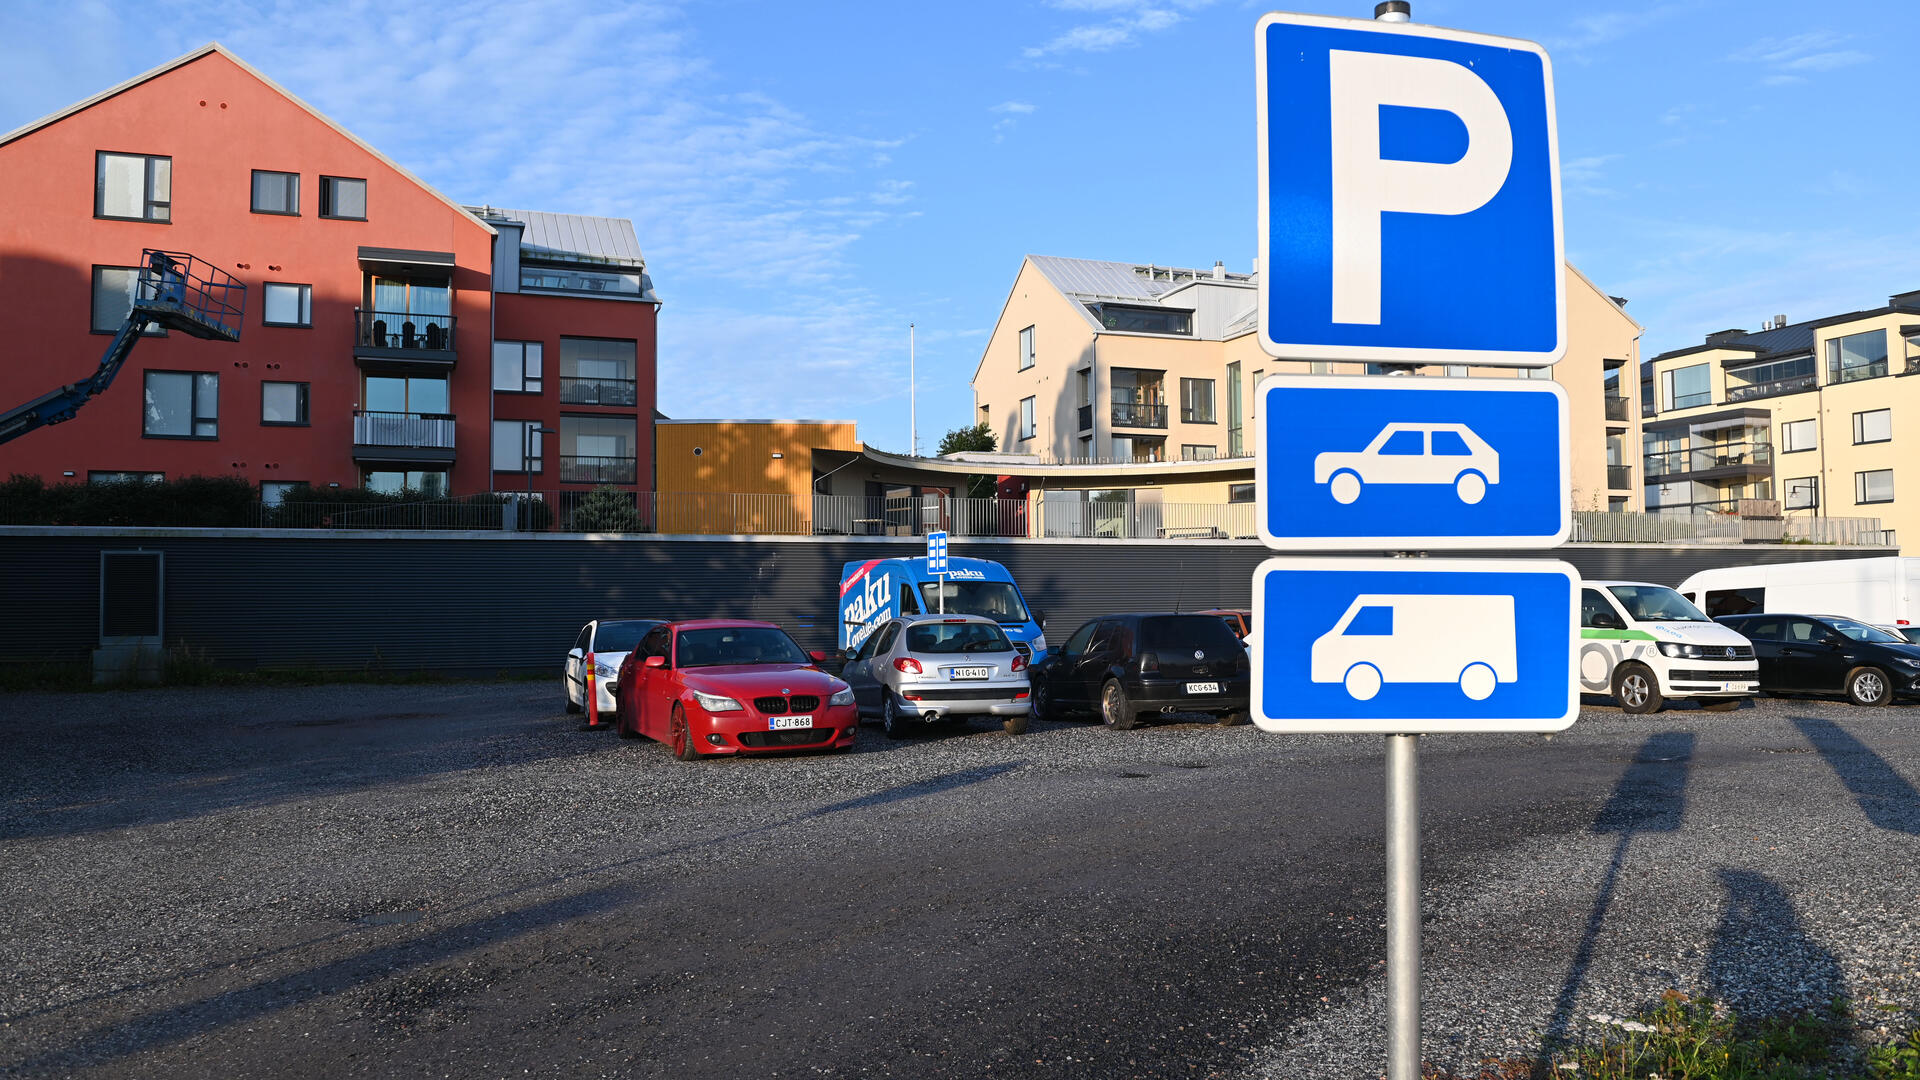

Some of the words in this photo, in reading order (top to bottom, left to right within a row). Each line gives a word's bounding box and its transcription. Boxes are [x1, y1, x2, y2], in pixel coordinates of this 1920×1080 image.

[1329, 49, 1513, 325] P
[948, 568, 984, 580] paku
[843, 570, 892, 651] paku
[955, 668, 986, 677] NIG-410
[1188, 683, 1217, 692] KCG-634
[775, 717, 811, 728] CJT-868
